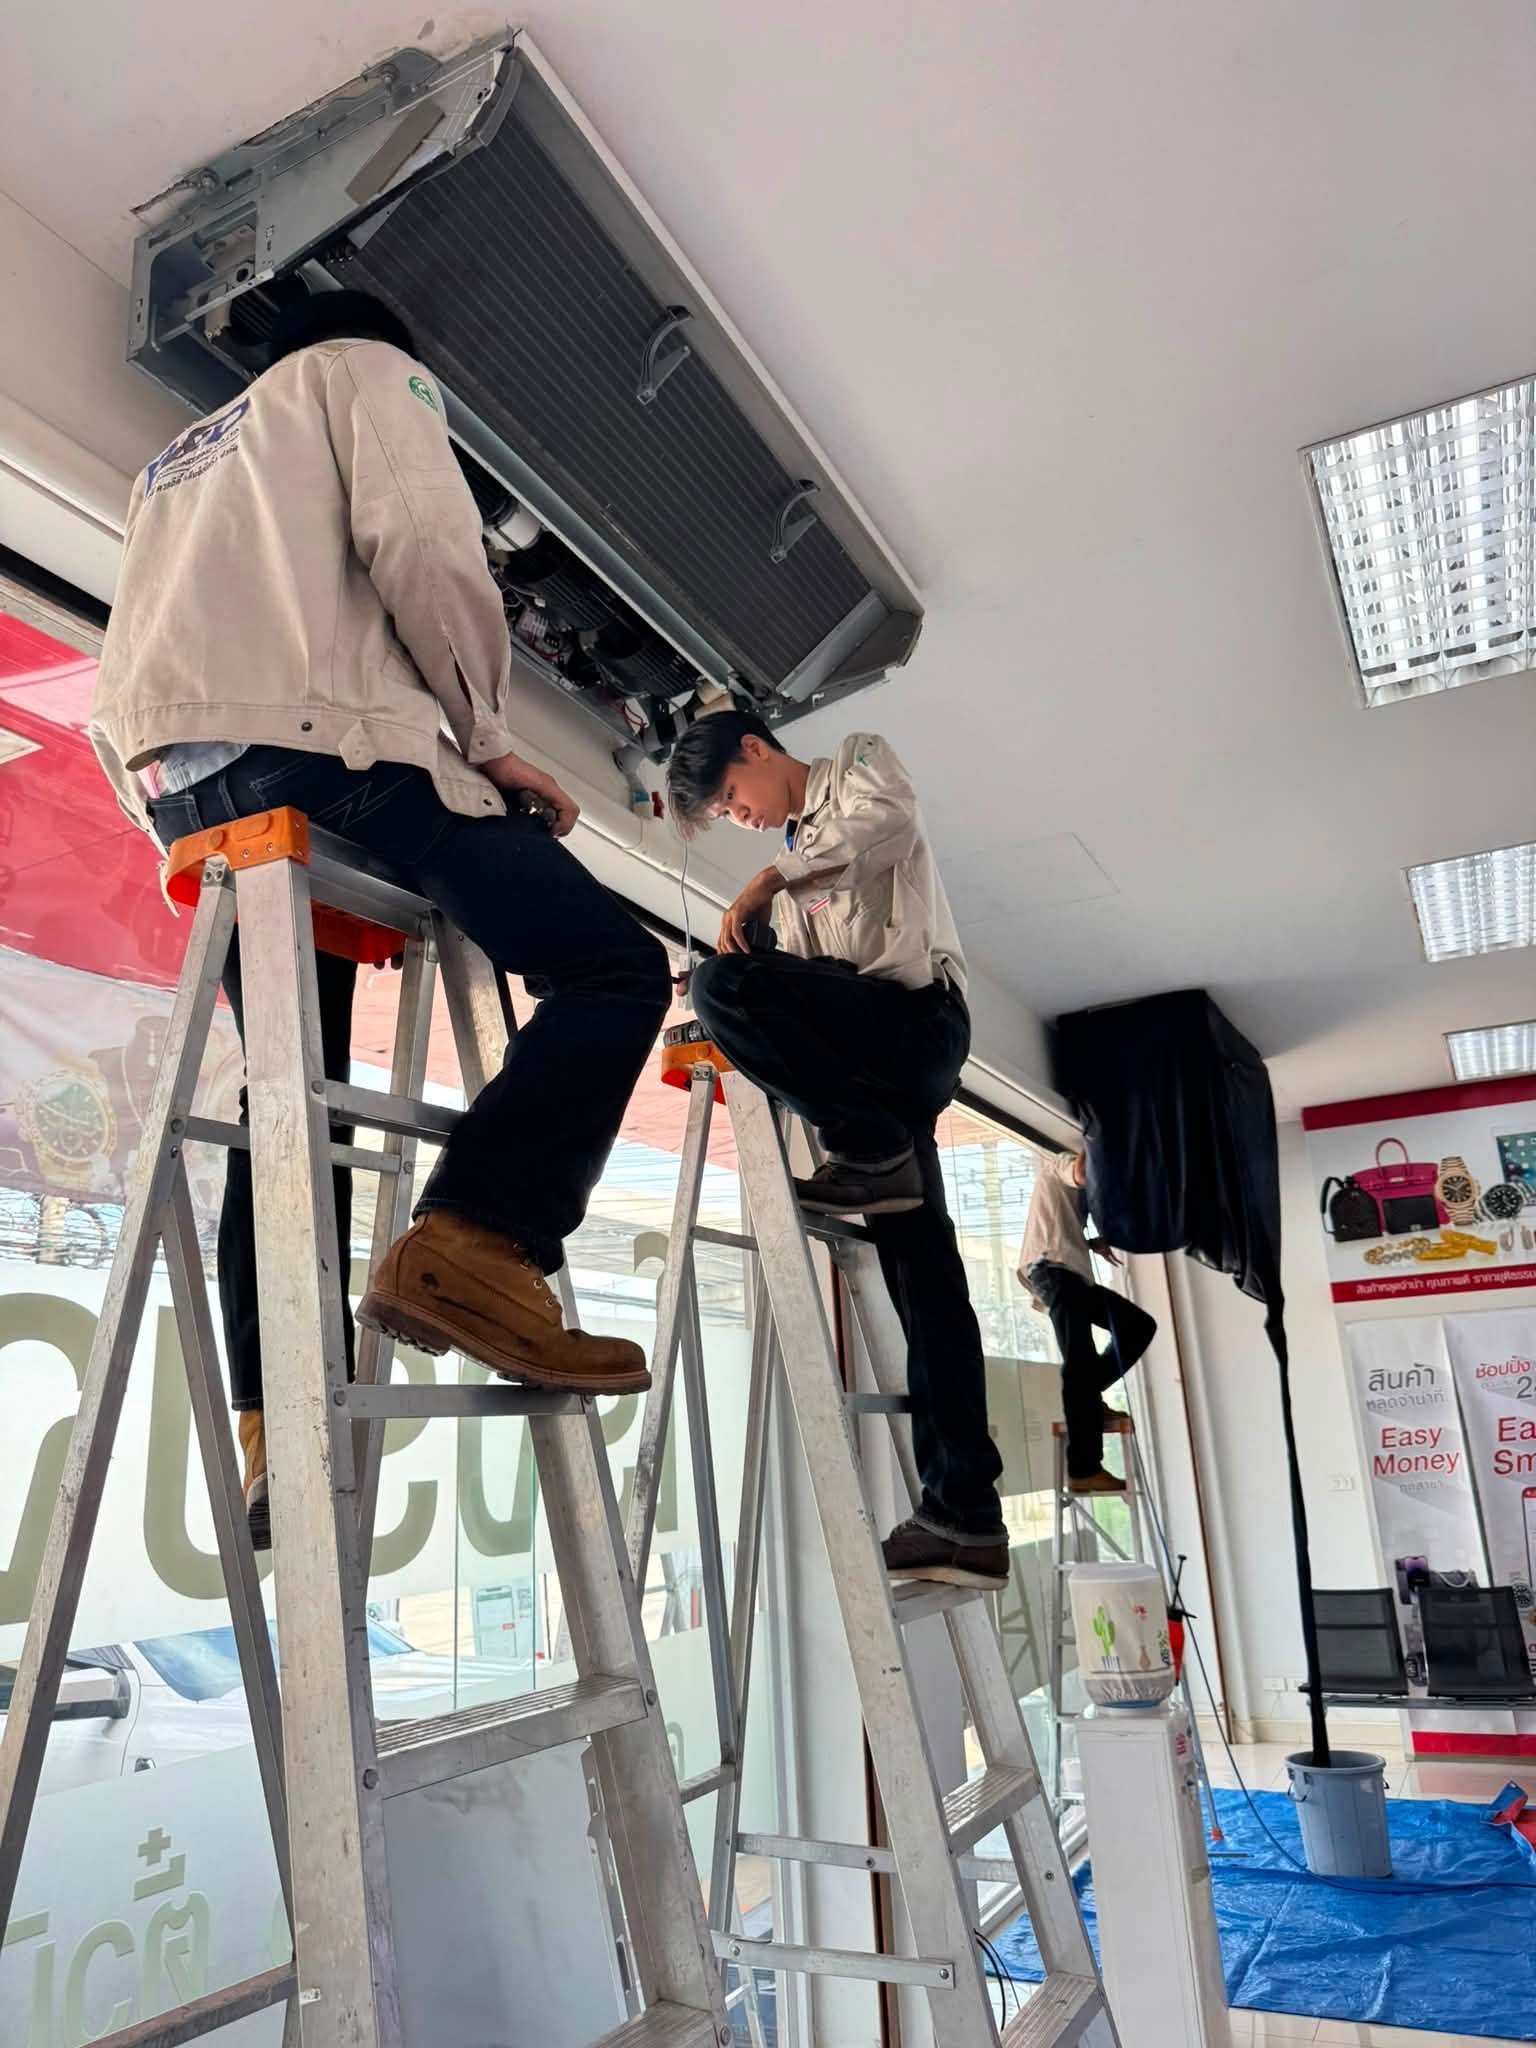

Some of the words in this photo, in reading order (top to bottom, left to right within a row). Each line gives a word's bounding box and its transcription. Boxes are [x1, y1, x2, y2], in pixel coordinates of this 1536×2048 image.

[1368, 1363, 1434, 1391] สินค้า
[1516, 1376, 1536, 1399] 2
[1382, 1427, 1442, 1449] Easy
[1374, 1452, 1459, 1477] Money
